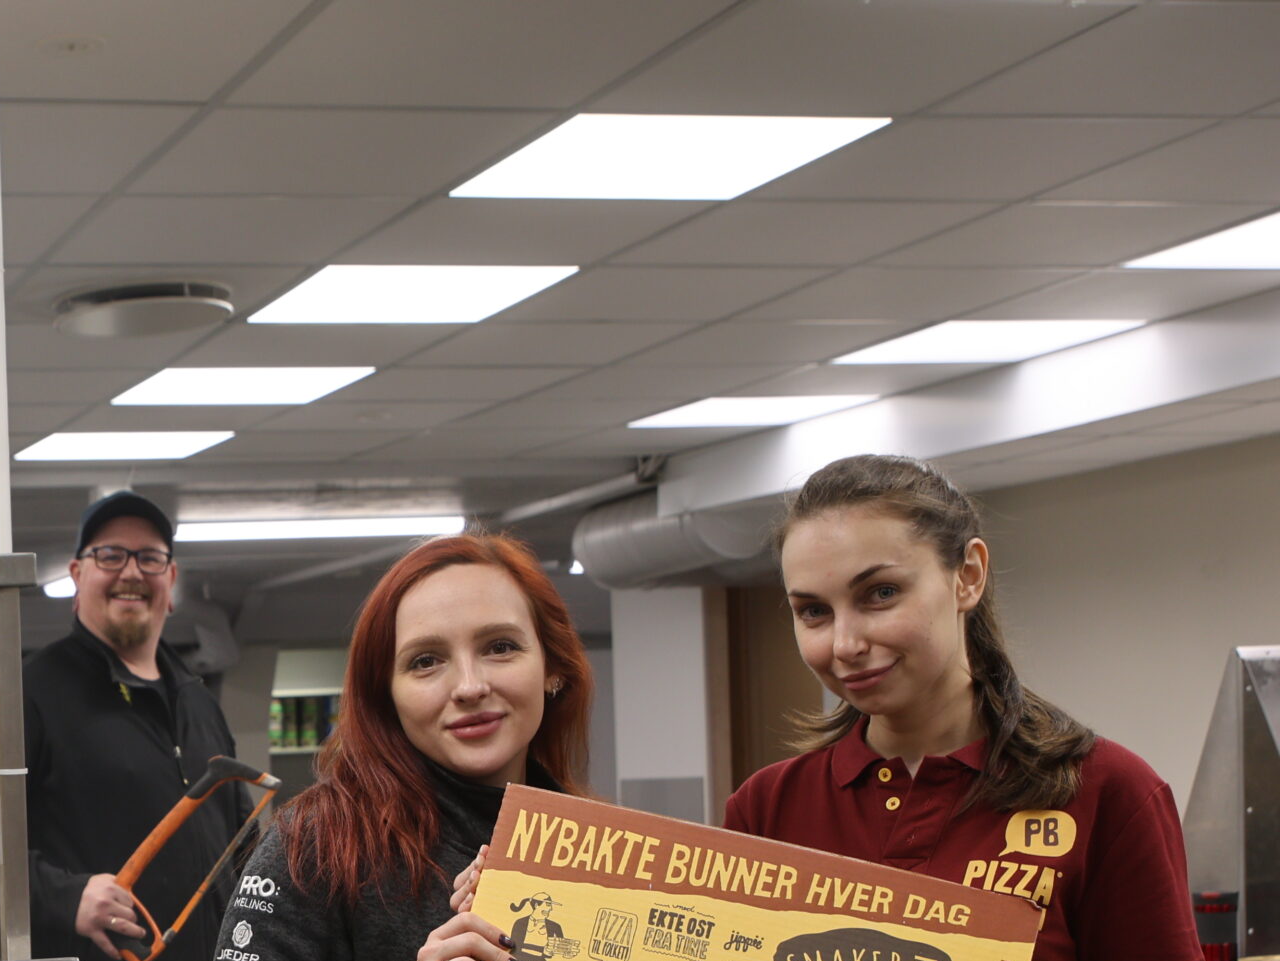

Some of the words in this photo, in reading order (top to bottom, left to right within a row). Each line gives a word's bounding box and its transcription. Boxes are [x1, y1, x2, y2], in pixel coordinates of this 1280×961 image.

[1024, 817, 1059, 847] PB
[506, 809, 660, 880] NYBAKTE
[665, 843, 797, 899] BUNNER
[805, 874, 893, 914] HVER
[903, 894, 971, 926] DAG
[963, 860, 1055, 906] PIZZA
[234, 897, 274, 913] MELINGS
[595, 910, 633, 946] PIZZA
[648, 908, 685, 933] EKTE
[687, 918, 715, 939] OST
[643, 927, 672, 951] FRA
[676, 934, 710, 959] TINE
